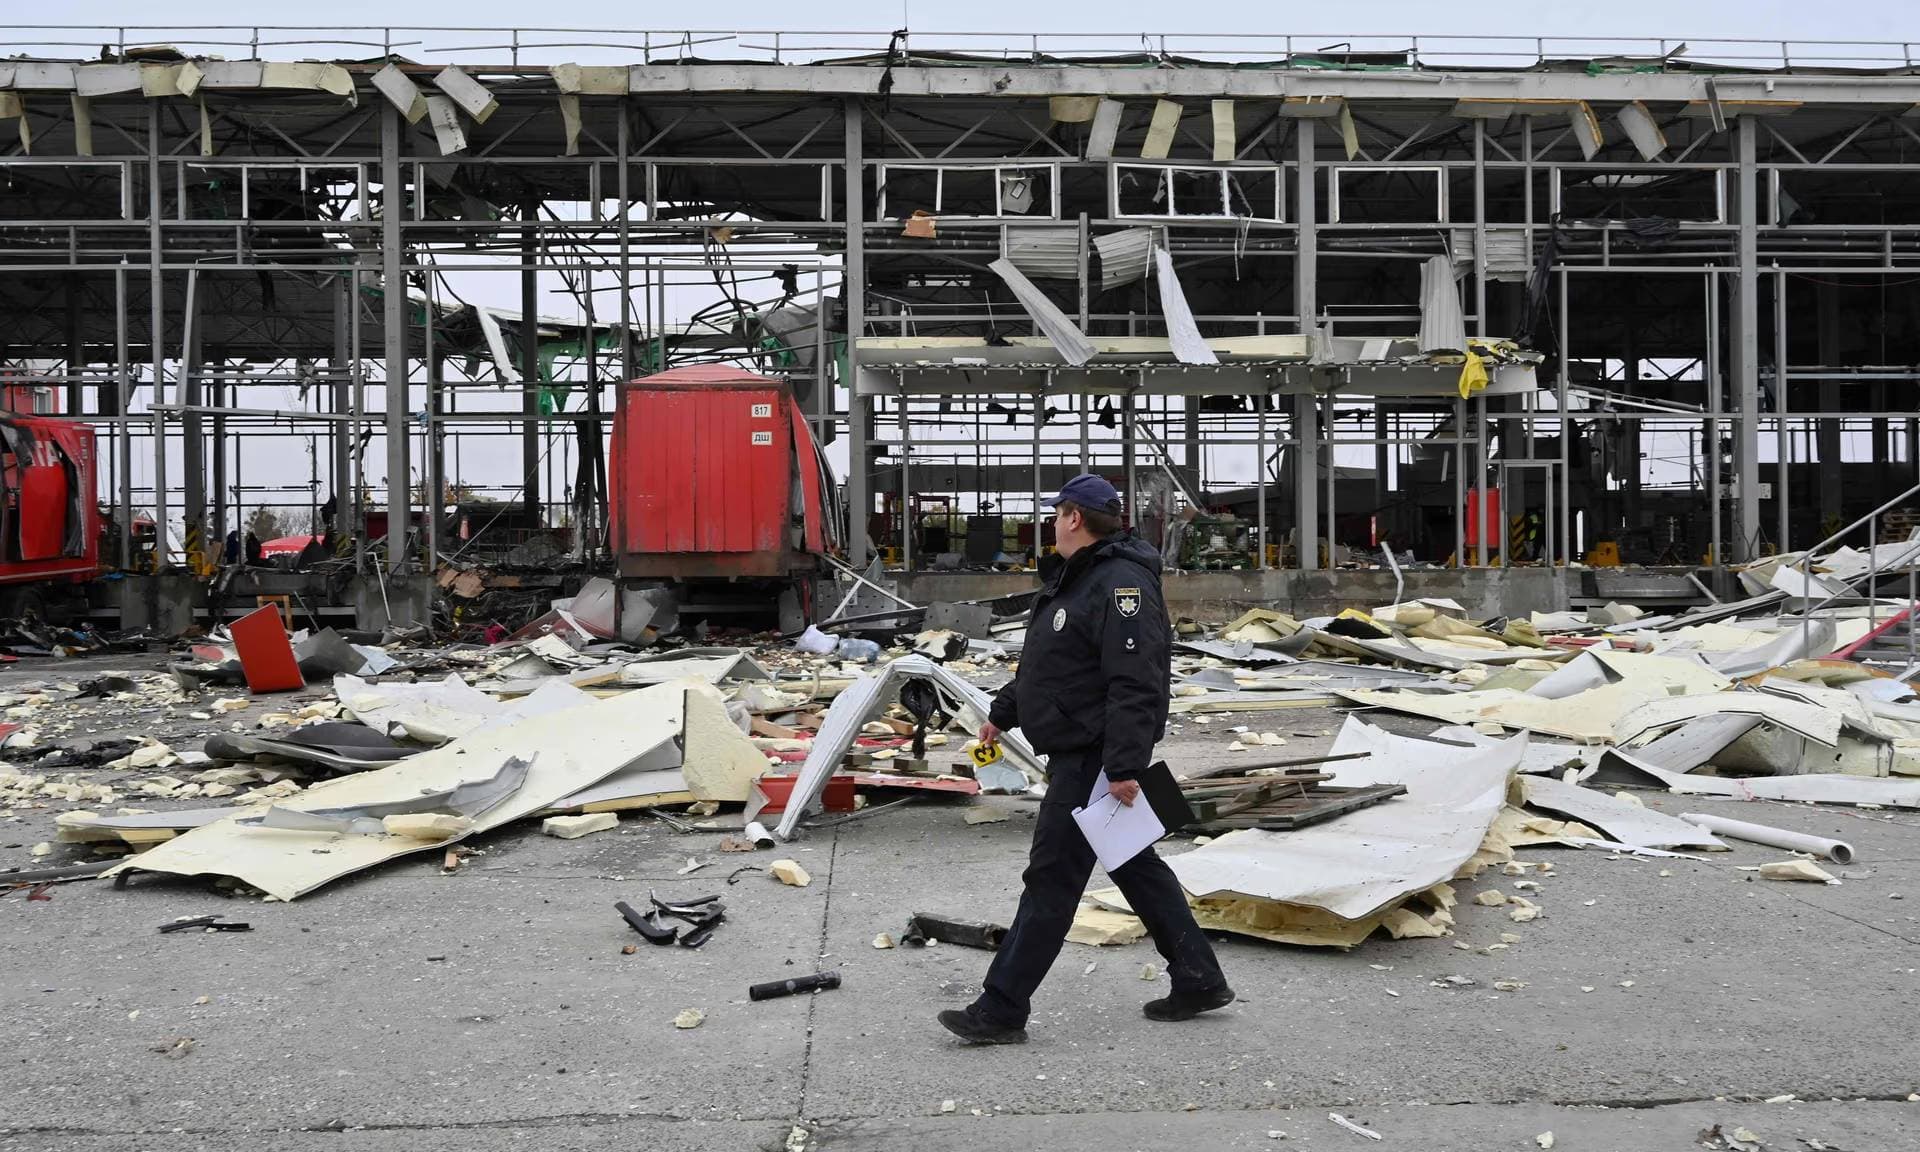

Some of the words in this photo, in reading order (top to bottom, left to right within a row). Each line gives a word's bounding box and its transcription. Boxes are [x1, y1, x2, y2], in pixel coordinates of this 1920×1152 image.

[754, 406, 768, 415] 817
[754, 433, 770, 442] ДШ
[32, 440, 60, 467] ТА
[974, 744, 996, 763] 3
